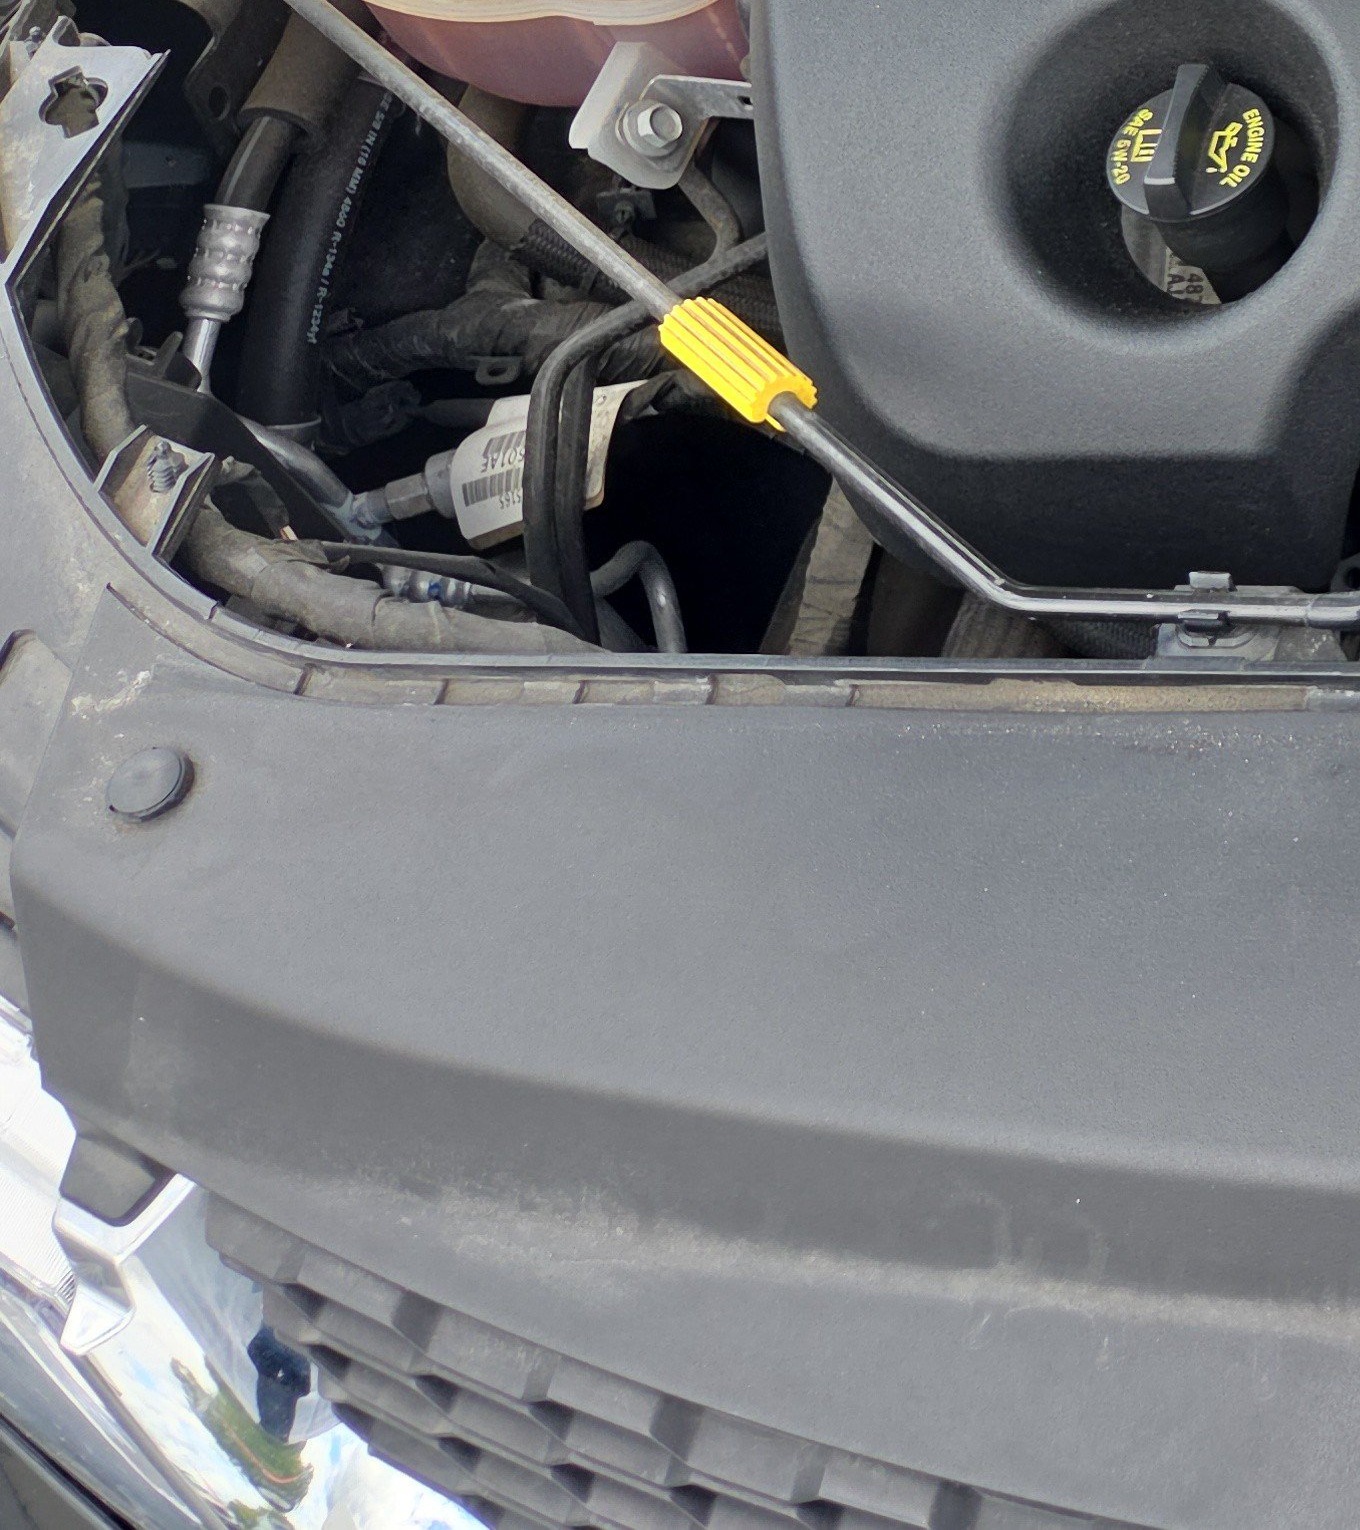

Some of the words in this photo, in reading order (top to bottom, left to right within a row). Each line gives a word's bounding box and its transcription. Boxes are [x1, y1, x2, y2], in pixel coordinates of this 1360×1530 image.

[1122, 108, 1154, 137] SAE
[1241, 107, 1265, 164] ENGINE
[1218, 163, 1251, 188] OIL
